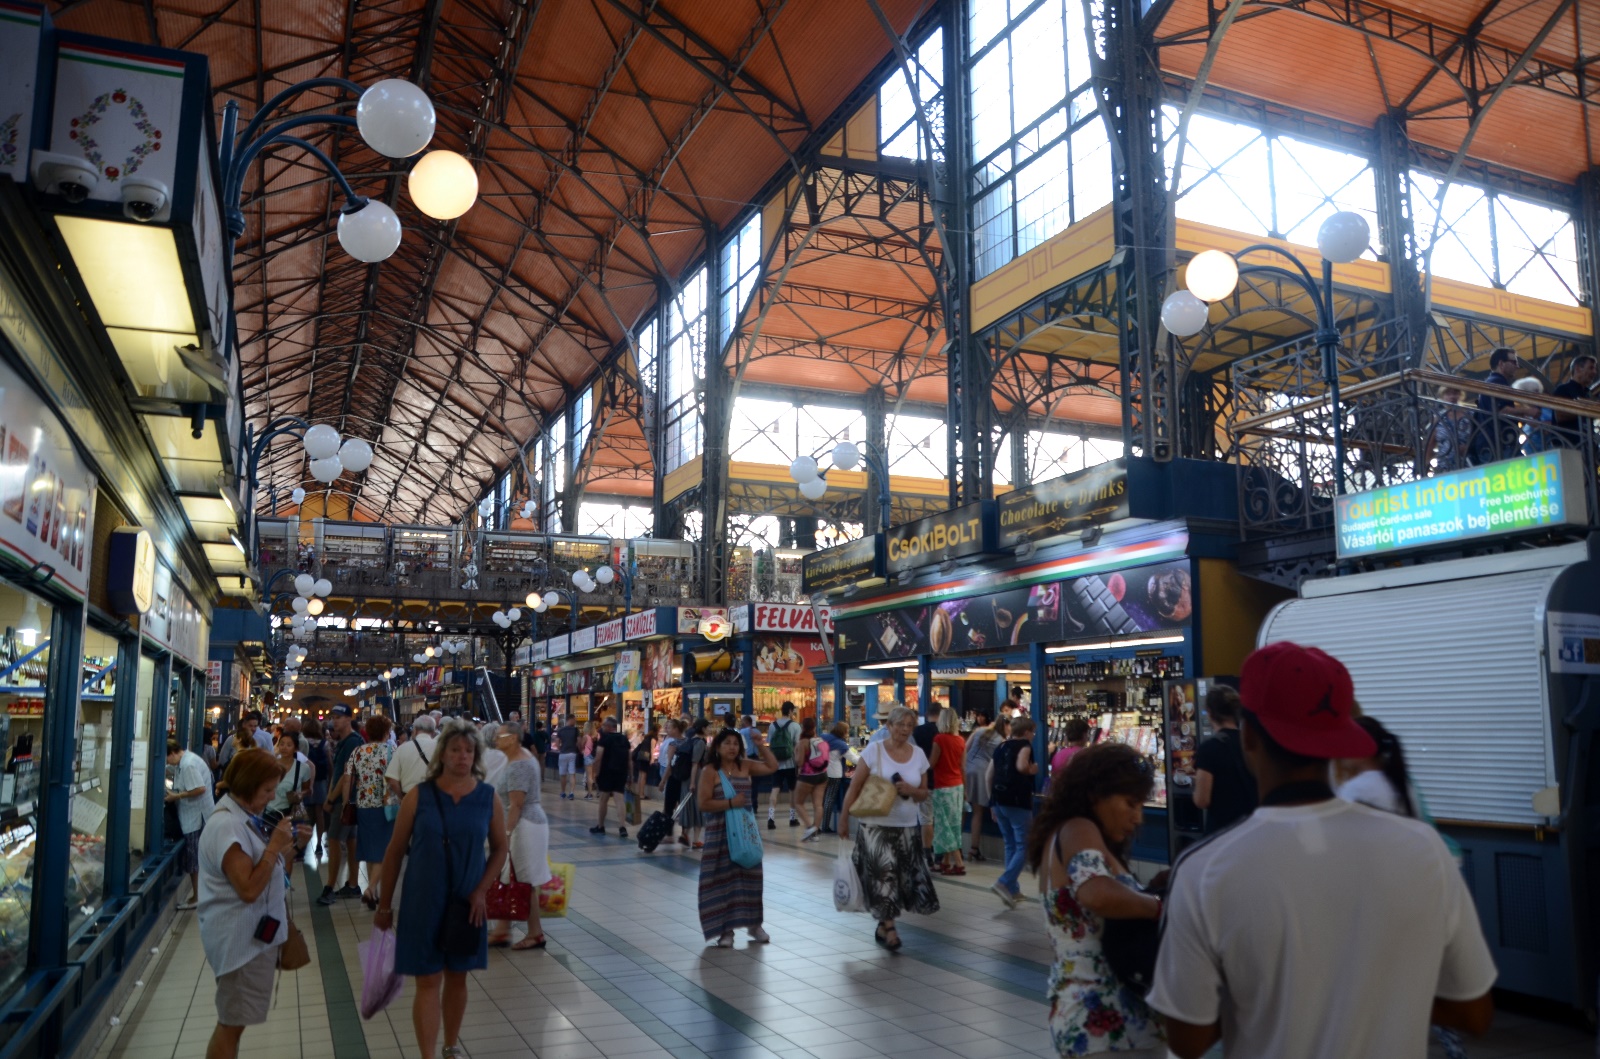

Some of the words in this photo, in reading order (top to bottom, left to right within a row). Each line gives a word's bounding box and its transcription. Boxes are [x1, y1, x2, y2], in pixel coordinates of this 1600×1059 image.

[1000, 500, 1058, 526] Chocolate
[1063, 494, 1073, 509] &
[1079, 479, 1124, 506] Drinks
[1338, 489, 1410, 520] Tourist
[1416, 463, 1557, 507] information
[1480, 497, 1501, 508] Free
[1503, 486, 1556, 504] brochures
[1341, 521, 1379, 533] Budapest
[1414, 509, 1433, 519] sale
[1342, 528, 1394, 550] Vásárlói
[1397, 516, 1464, 543] panaszok
[1467, 502, 1559, 530] bejelentése
[756, 605, 834, 630] FELVÁG
